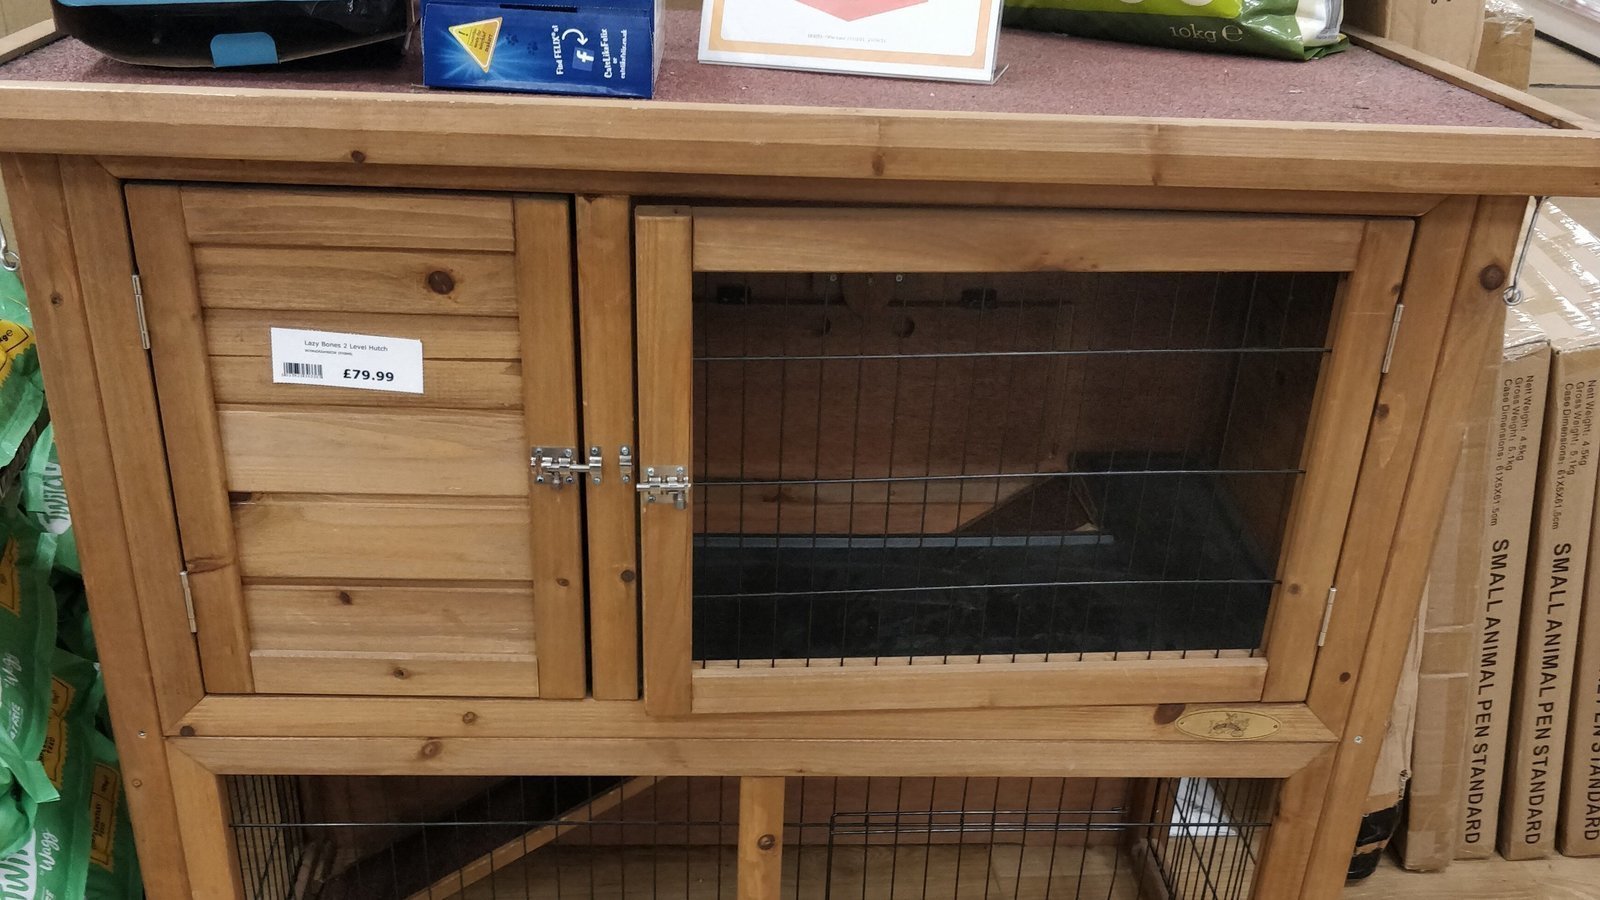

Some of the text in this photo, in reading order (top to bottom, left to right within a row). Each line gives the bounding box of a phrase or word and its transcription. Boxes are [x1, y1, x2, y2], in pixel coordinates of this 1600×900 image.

[1169, 24, 1217, 43] 10kg
[304, 340, 319, 348] Lazy
[343, 368, 394, 382] £79.99
[1524, 375, 1534, 395] Nett
[1502, 379, 1513, 403] Case
[1513, 377, 1524, 404] Gross
[1563, 383, 1573, 407] Case
[1574, 382, 1585, 409] Gross
[1586, 380, 1597, 399] Nett
[1516, 436, 1527, 461] 4.5kg
[1577, 441, 1590, 466] 4.5kg
[1566, 451, 1578, 476] 5.1kg
[1464, 539, 1510, 845] SMALL ANIMAL PEN STANDARD
[1524, 542, 1572, 845] SMALL ANIMAL PEN STANDARD
[38, 827, 60, 871] Wagg
